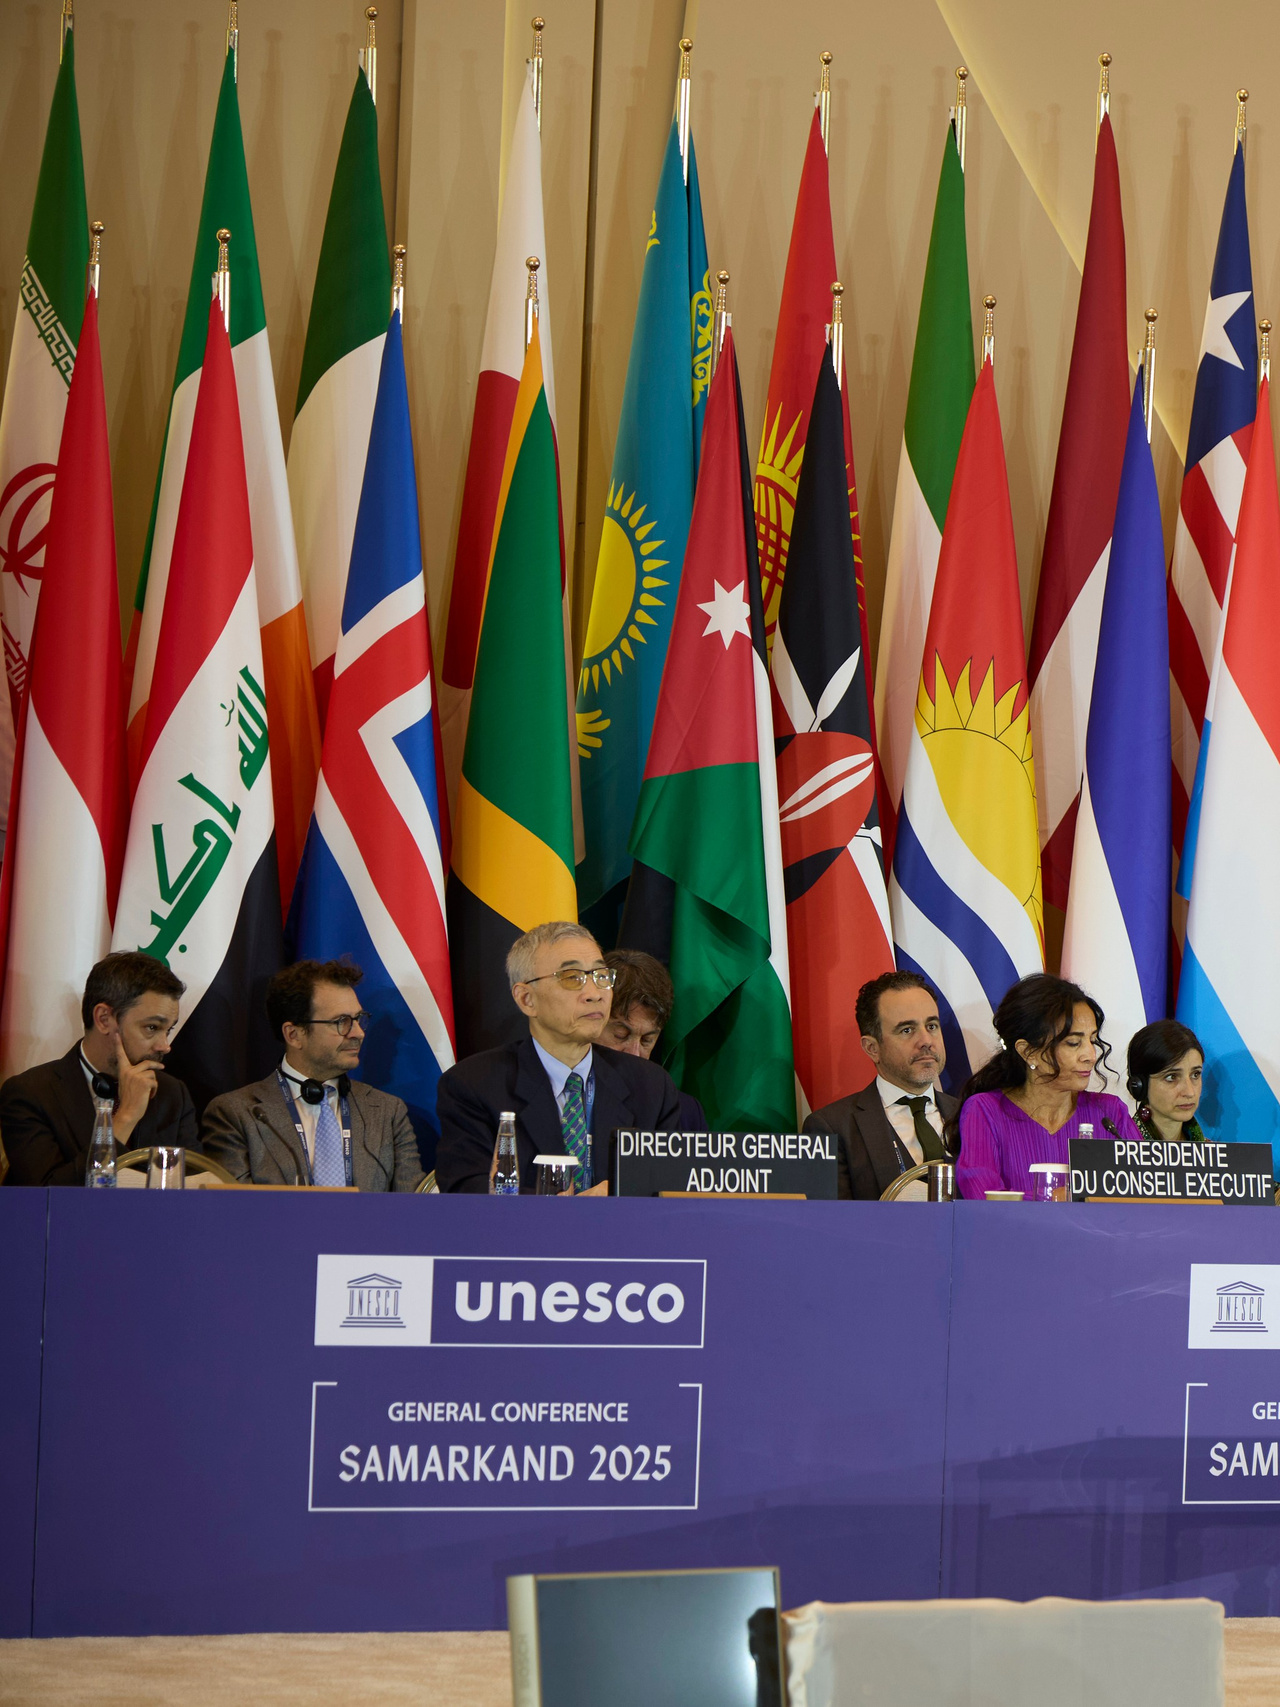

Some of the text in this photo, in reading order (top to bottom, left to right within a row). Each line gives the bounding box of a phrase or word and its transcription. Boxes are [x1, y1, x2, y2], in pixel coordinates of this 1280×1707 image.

[620, 1131, 837, 1161] DIRECTEUR GENERAL
[1114, 1140, 1229, 1168] PRESIDENTE
[685, 1167, 773, 1194] ADJOINT
[1071, 1169, 1272, 1199] DU CONSEIL EXECUTIF
[349, 1289, 399, 1316] UNESCO
[455, 1281, 685, 1324] unesco
[1218, 1296, 1262, 1321] UNESCO
[387, 1401, 629, 1423] GENERAL CONFERENCE
[338, 1444, 672, 1482] SAMARKAND 2025
